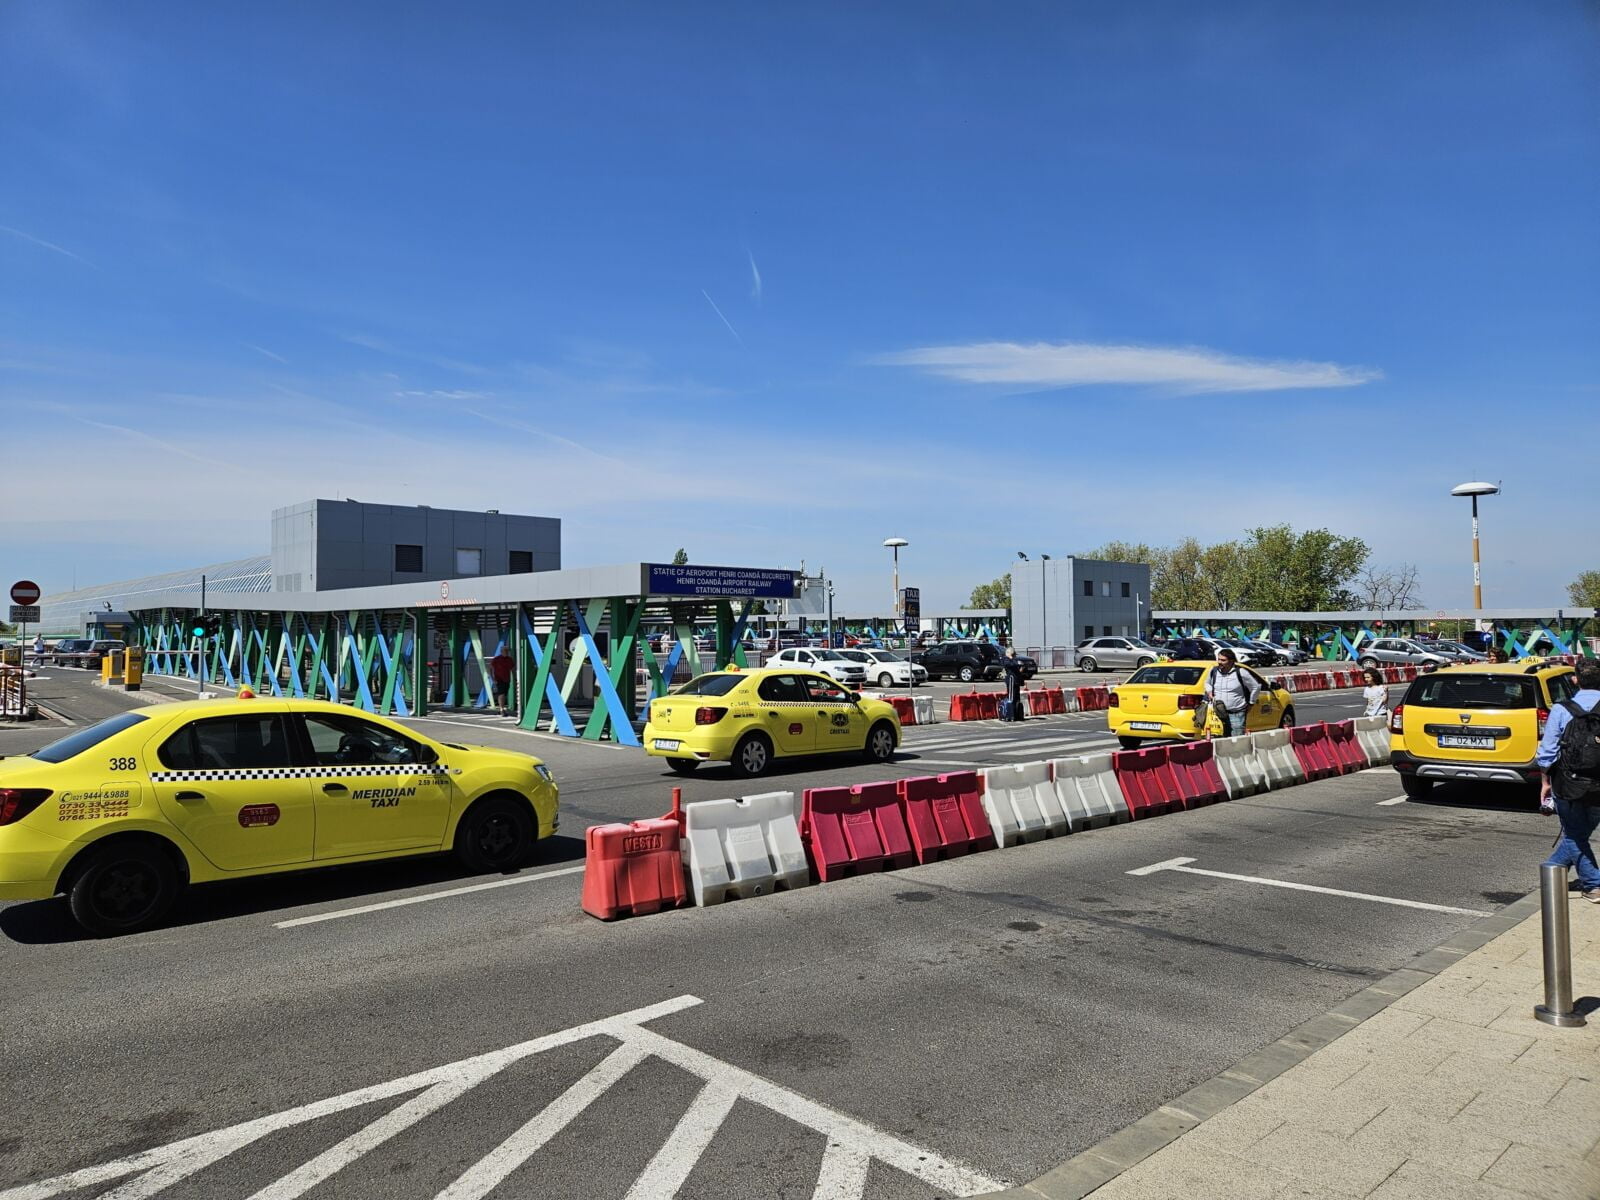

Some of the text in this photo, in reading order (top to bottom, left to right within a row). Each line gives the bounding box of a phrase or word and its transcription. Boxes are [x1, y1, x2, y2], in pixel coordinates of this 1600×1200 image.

[686, 569, 717, 577] AEROPORT
[676, 577, 696, 585] HENRI
[695, 586, 756, 595] STATION BUCHAREST
[906, 589, 919, 598] TAXI
[905, 616, 920, 625] TAXI
[1456, 736, 1469, 745] 02
[1470, 737, 1491, 745] MXT
[109, 757, 137, 771] 388
[352, 787, 416, 800] MERIDIAN
[370, 797, 400, 808] TAXI
[625, 835, 661, 853] VESTA
